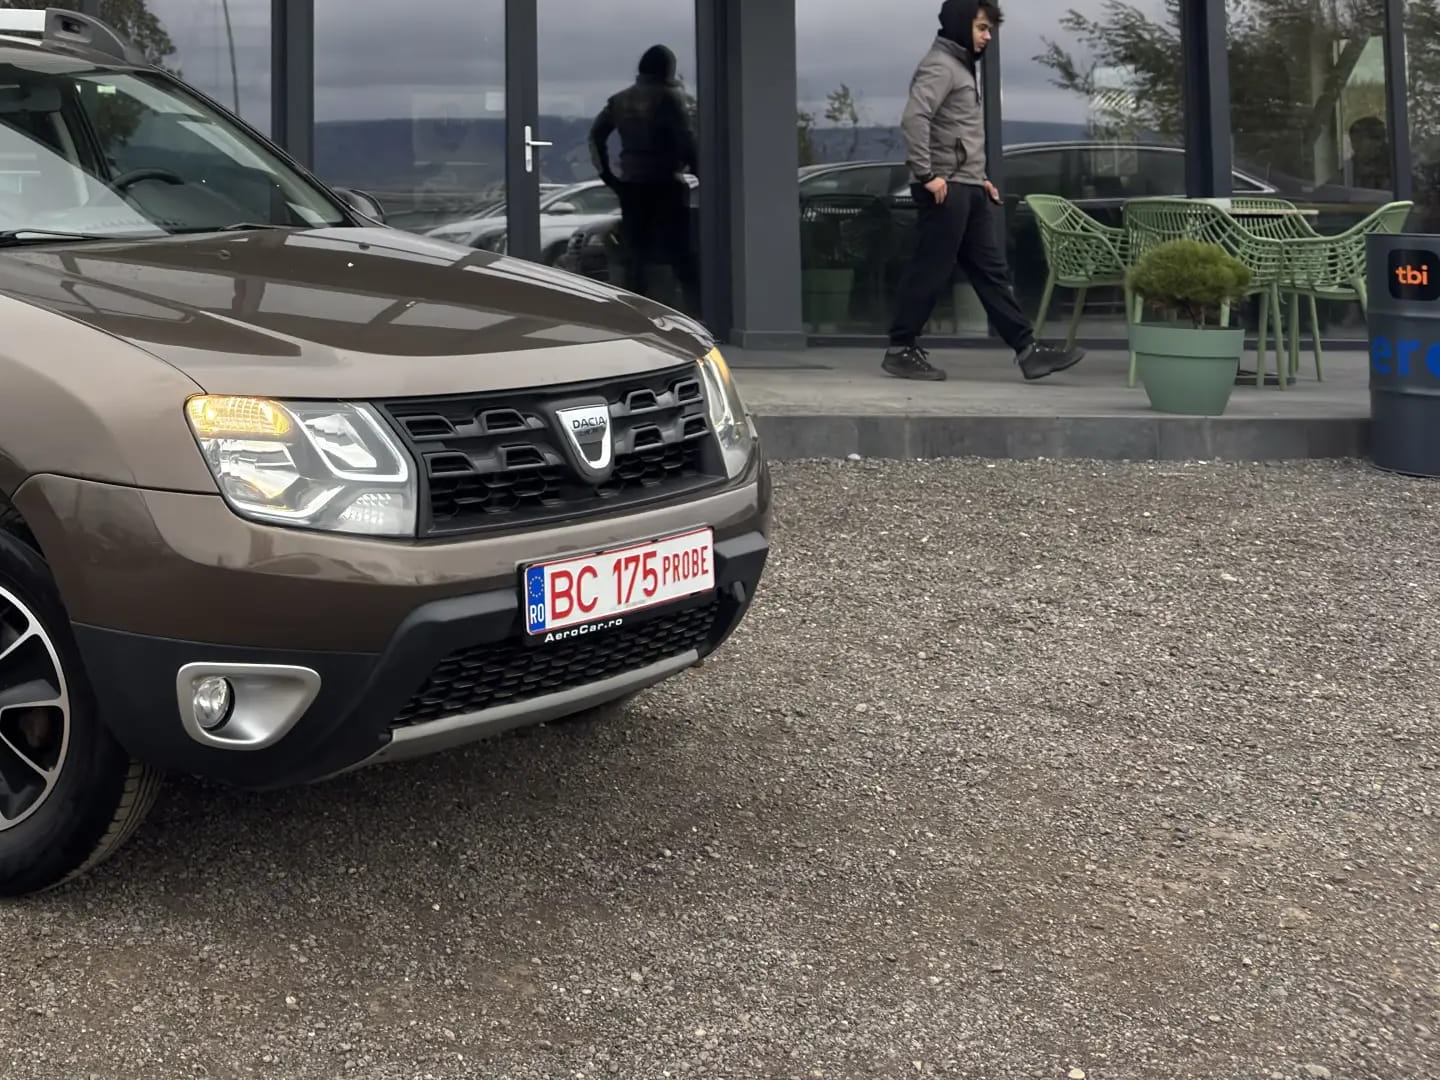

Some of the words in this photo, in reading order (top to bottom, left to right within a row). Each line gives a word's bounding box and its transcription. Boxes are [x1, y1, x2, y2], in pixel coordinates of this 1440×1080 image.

[1395, 265, 1428, 285] tbi
[572, 416, 606, 429] DACIA
[550, 566, 598, 620] BC
[613, 551, 658, 606] 175
[663, 545, 709, 586] PROBE
[530, 603, 545, 624] RO
[544, 618, 623, 643] AeroCar.ro
